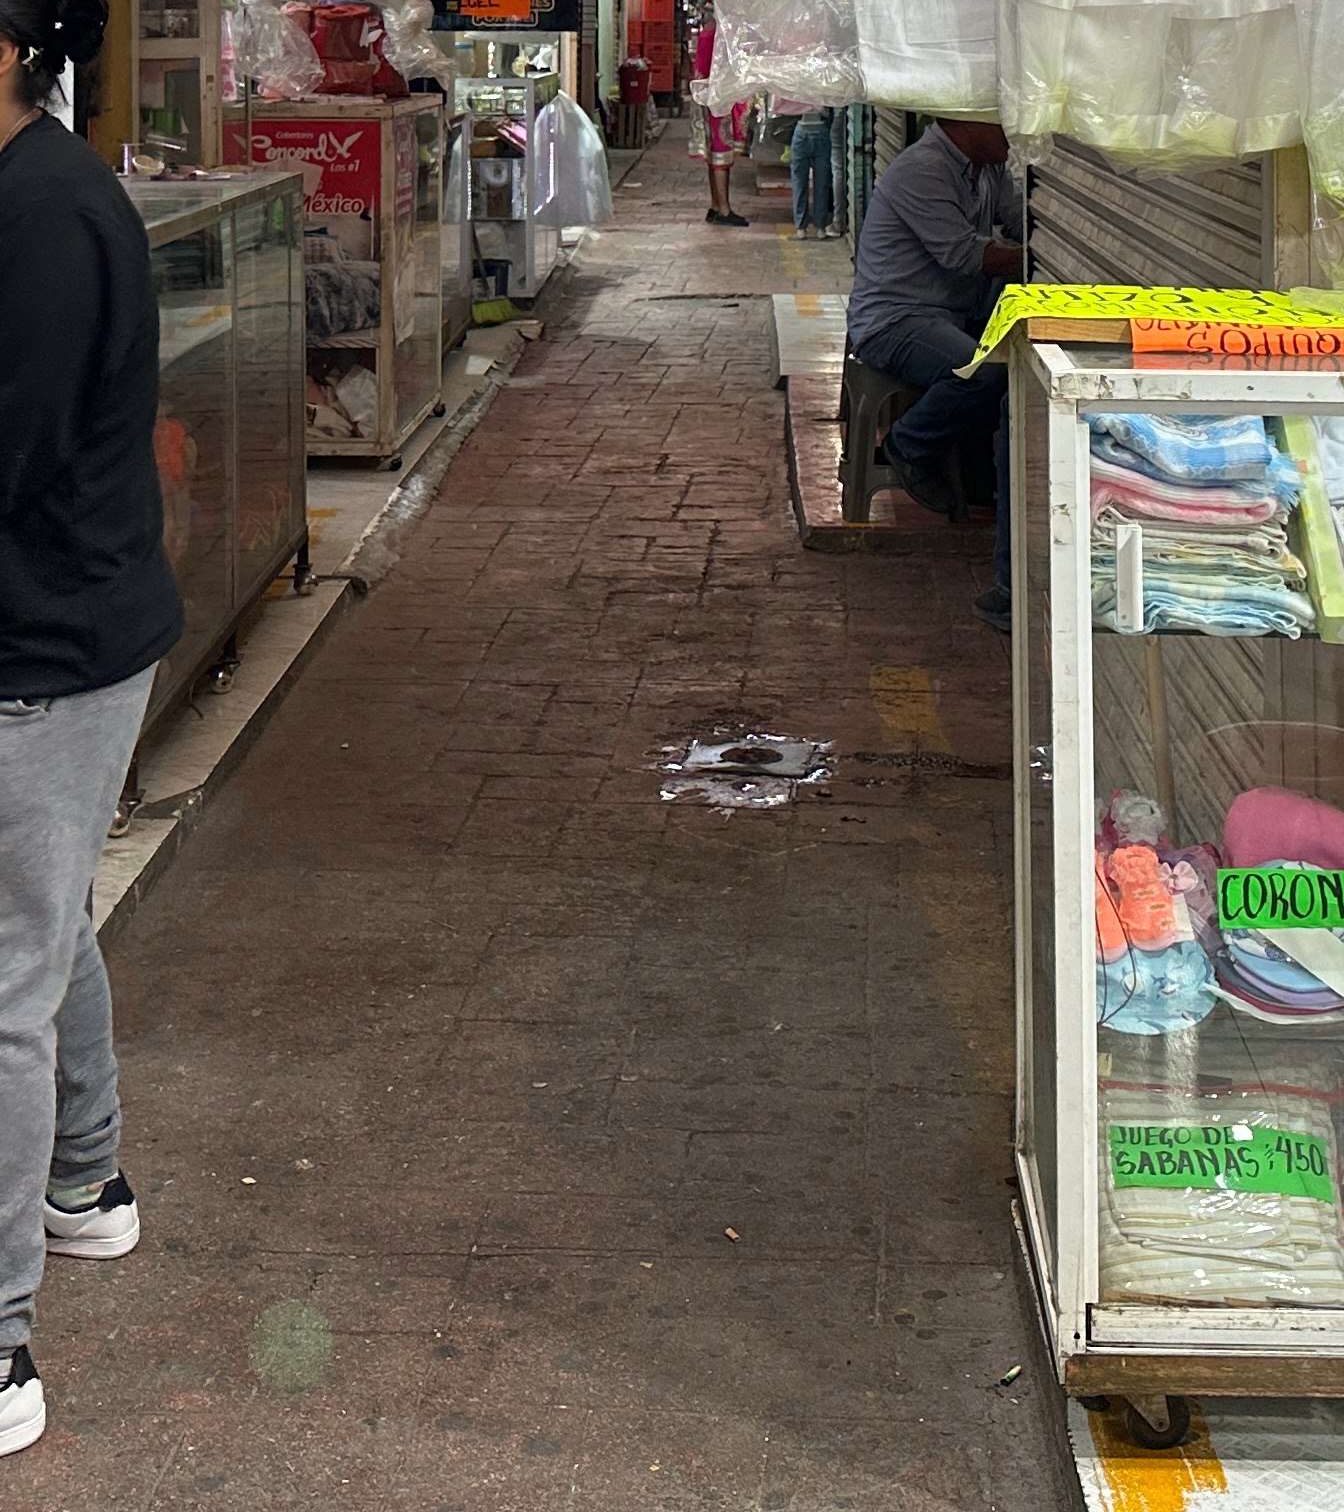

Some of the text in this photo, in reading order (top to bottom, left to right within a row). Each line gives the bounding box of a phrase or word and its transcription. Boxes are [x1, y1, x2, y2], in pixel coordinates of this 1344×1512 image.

[1115, 1125, 1236, 1148] JUEGO DE
[1115, 1146, 1260, 1178] SABANAS
